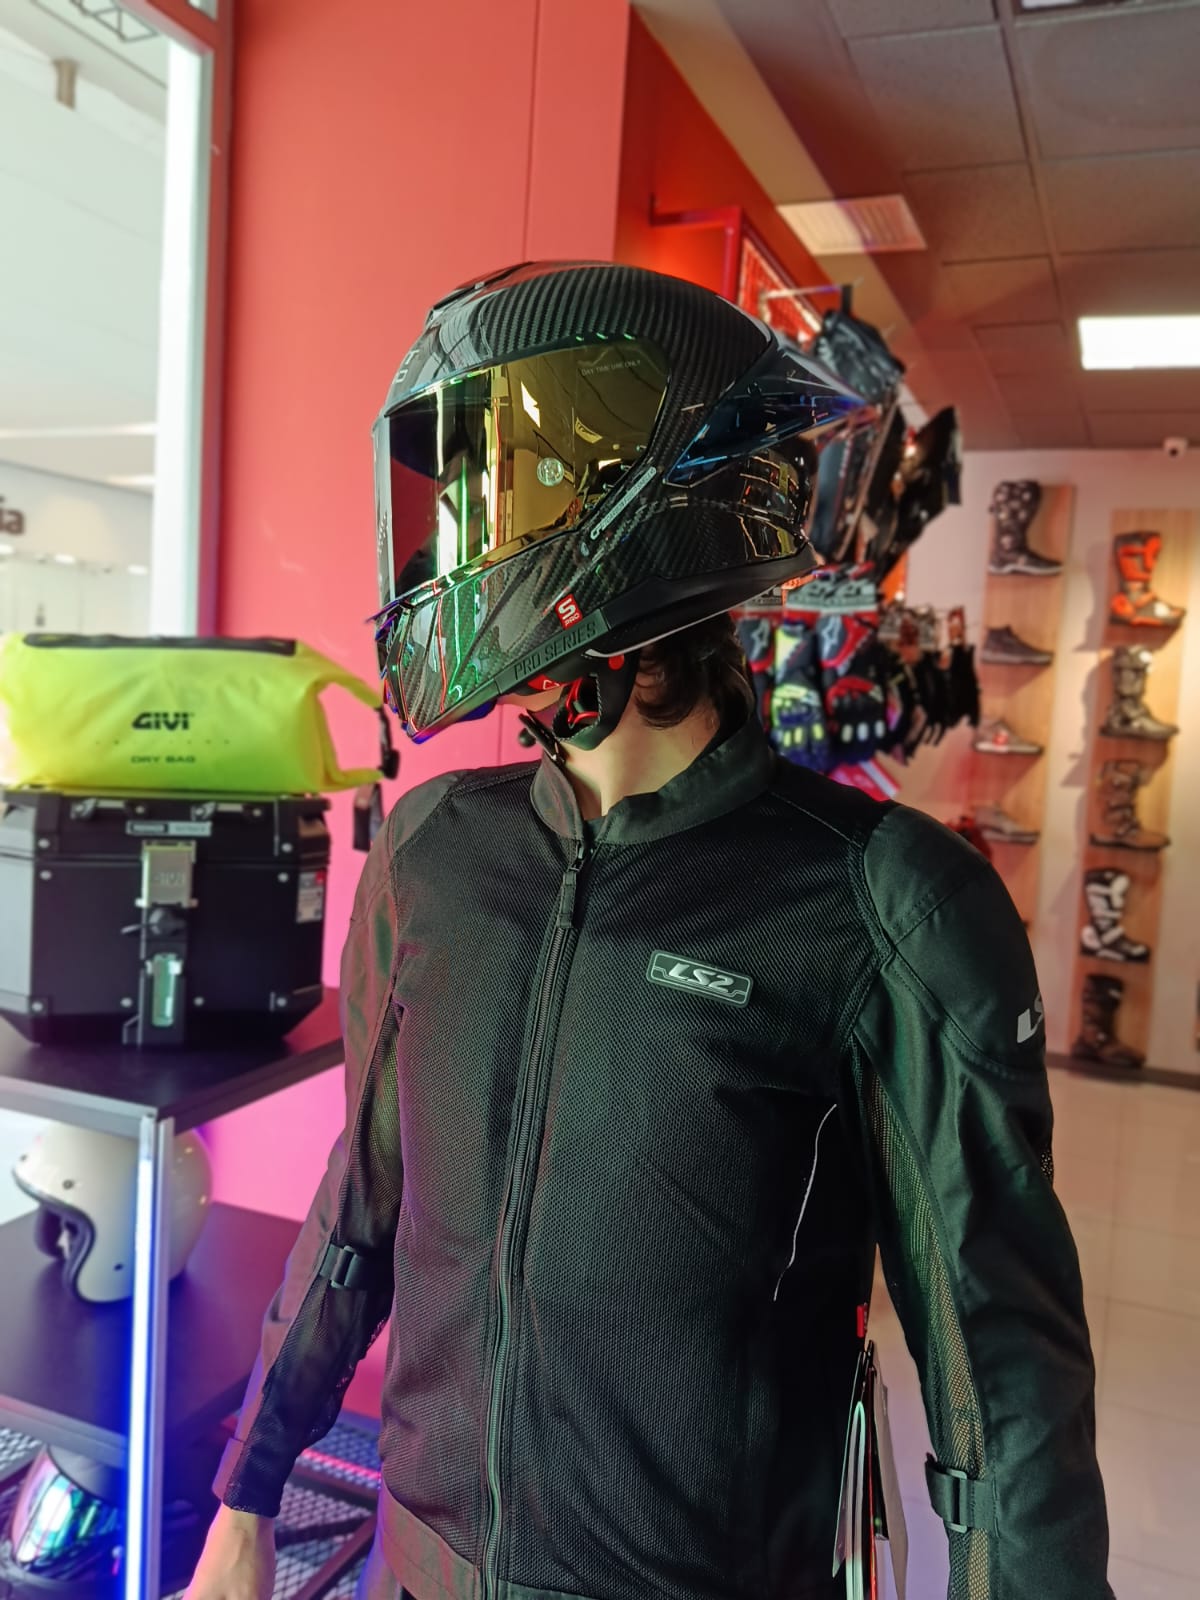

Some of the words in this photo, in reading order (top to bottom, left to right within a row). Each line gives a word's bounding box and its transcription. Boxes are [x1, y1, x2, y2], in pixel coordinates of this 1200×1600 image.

[513, 652, 541, 681] PRO
[544, 620, 597, 662] SERIES
[132, 711, 189, 731] GIVI
[131, 755, 160, 764] DRY
[165, 755, 195, 764] BAG
[668, 962, 735, 994] LS2
